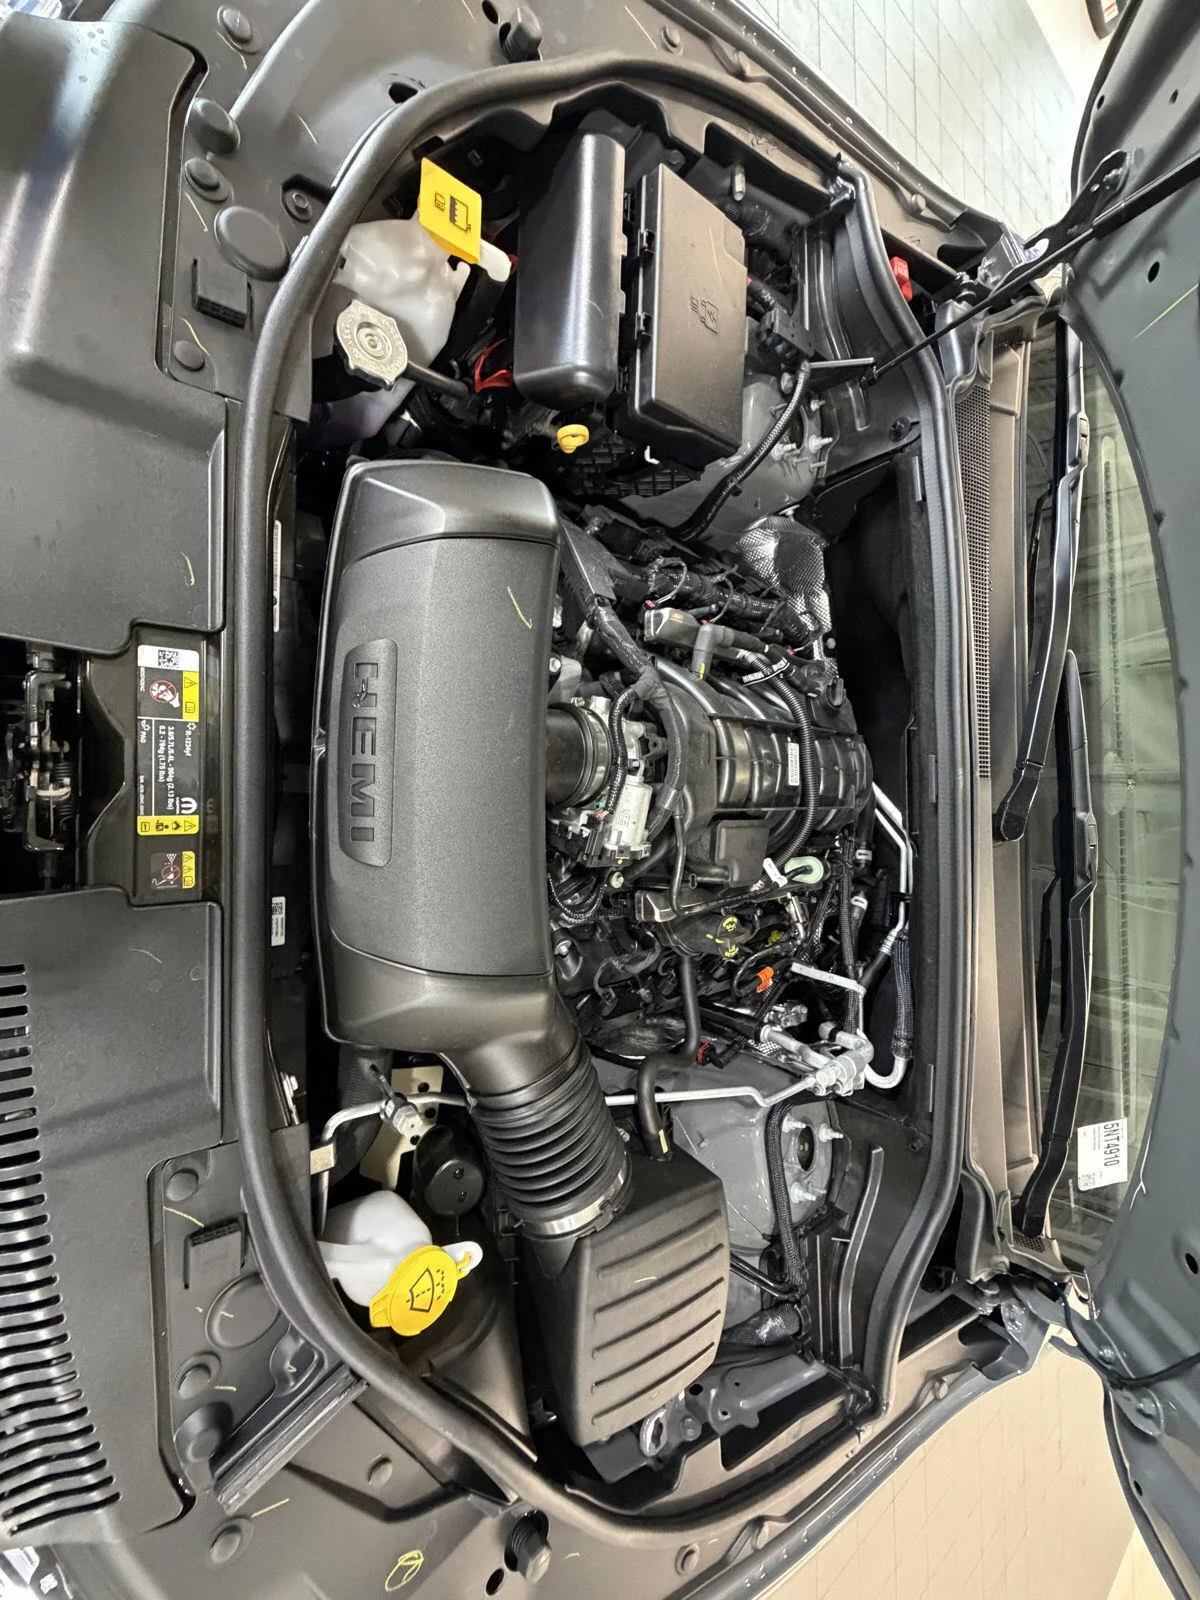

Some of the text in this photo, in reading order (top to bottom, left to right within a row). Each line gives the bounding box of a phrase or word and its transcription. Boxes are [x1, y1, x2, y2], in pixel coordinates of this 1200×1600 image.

[184, 730, 192, 756] R-1234yf
[350, 663, 379, 842] HEMI
[157, 770, 166, 782] lbs)
[166, 798, 174, 810] lbs)
[1104, 1122, 1120, 1166] 5NT4910
